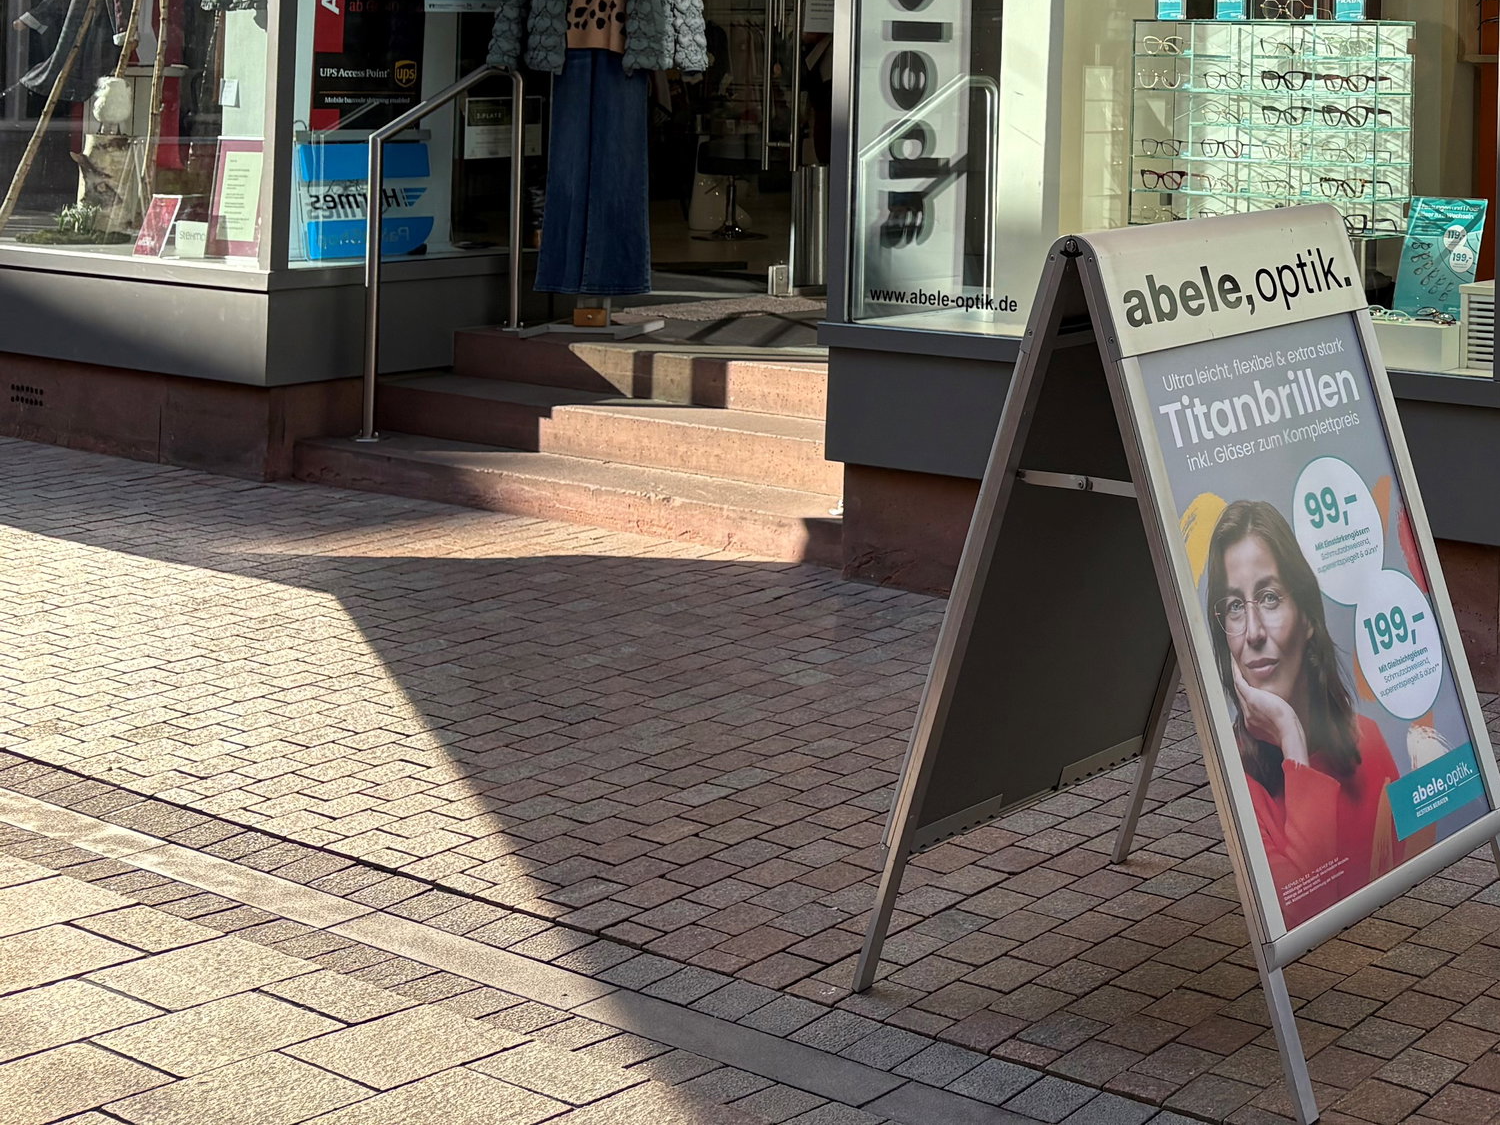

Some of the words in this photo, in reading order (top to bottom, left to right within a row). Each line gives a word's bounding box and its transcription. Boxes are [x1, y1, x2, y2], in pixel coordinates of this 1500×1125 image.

[320, 67, 338, 78] UPS
[338, 68, 365, 78] Access
[396, 68, 415, 84] ups
[870, 289, 1018, 313] www.abele-optik.de
[1123, 248, 1353, 328] abele,optik.
[1162, 373, 1195, 392] Ultra
[1195, 364, 1234, 385] leicht,
[1234, 352, 1275, 376] flexibel
[1276, 351, 1286, 366] &
[1287, 344, 1317, 363] extra
[1317, 338, 1345, 357] stark
[1159, 368, 1360, 449] Titanbrillen
[1186, 452, 1213, 472] inkl.
[1214, 440, 1256, 464] Gläser
[1258, 433, 1283, 452] zum
[1283, 411, 1360, 445] Komplettpreis
[1304, 486, 1358, 530] 99,-
[1314, 540, 1324, 552] Mit
[1363, 605, 1426, 656] 199,-
[1378, 663, 1388, 675] Mit
[1411, 761, 1473, 804] abele,optik.
